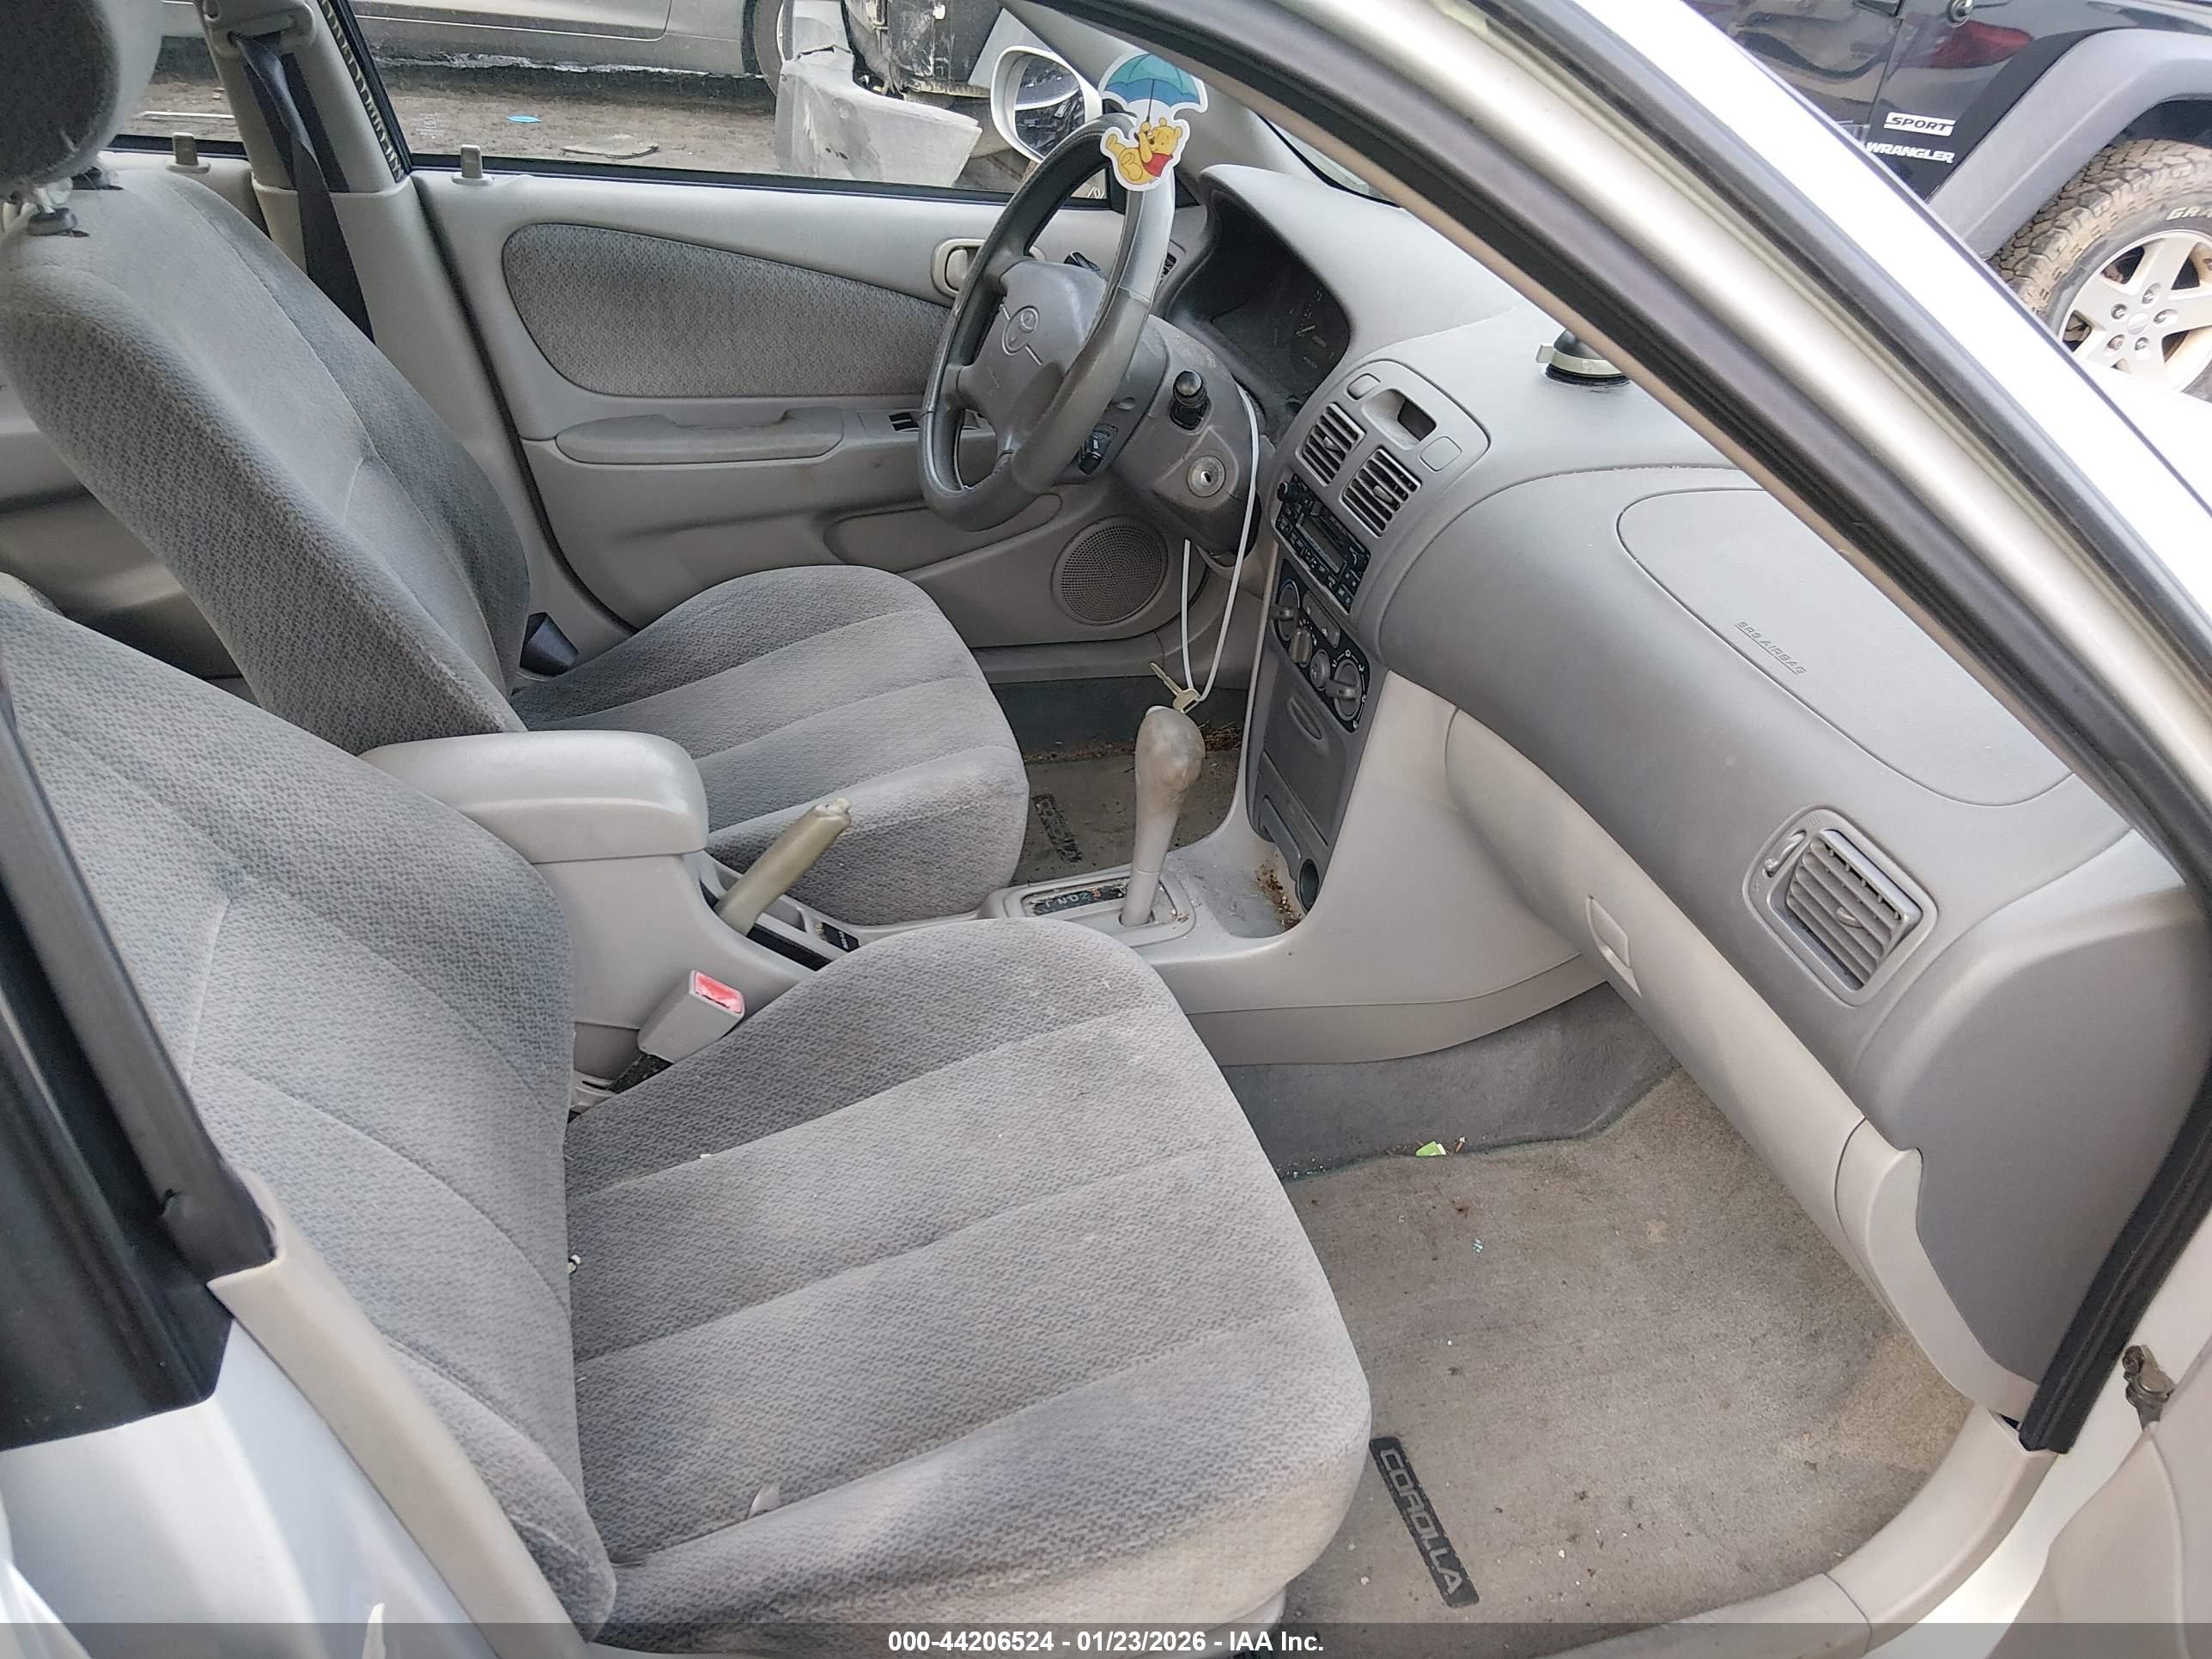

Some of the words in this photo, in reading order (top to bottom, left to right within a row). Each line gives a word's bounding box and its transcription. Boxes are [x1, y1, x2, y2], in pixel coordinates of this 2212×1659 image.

[1891, 117, 1948, 131] SPORT
[1866, 142, 1955, 164] WRANGLER
[1737, 621, 1762, 639] SRS
[1759, 640, 1808, 674] AIRBAG
[1380, 1449, 1463, 1595] COROLLA
